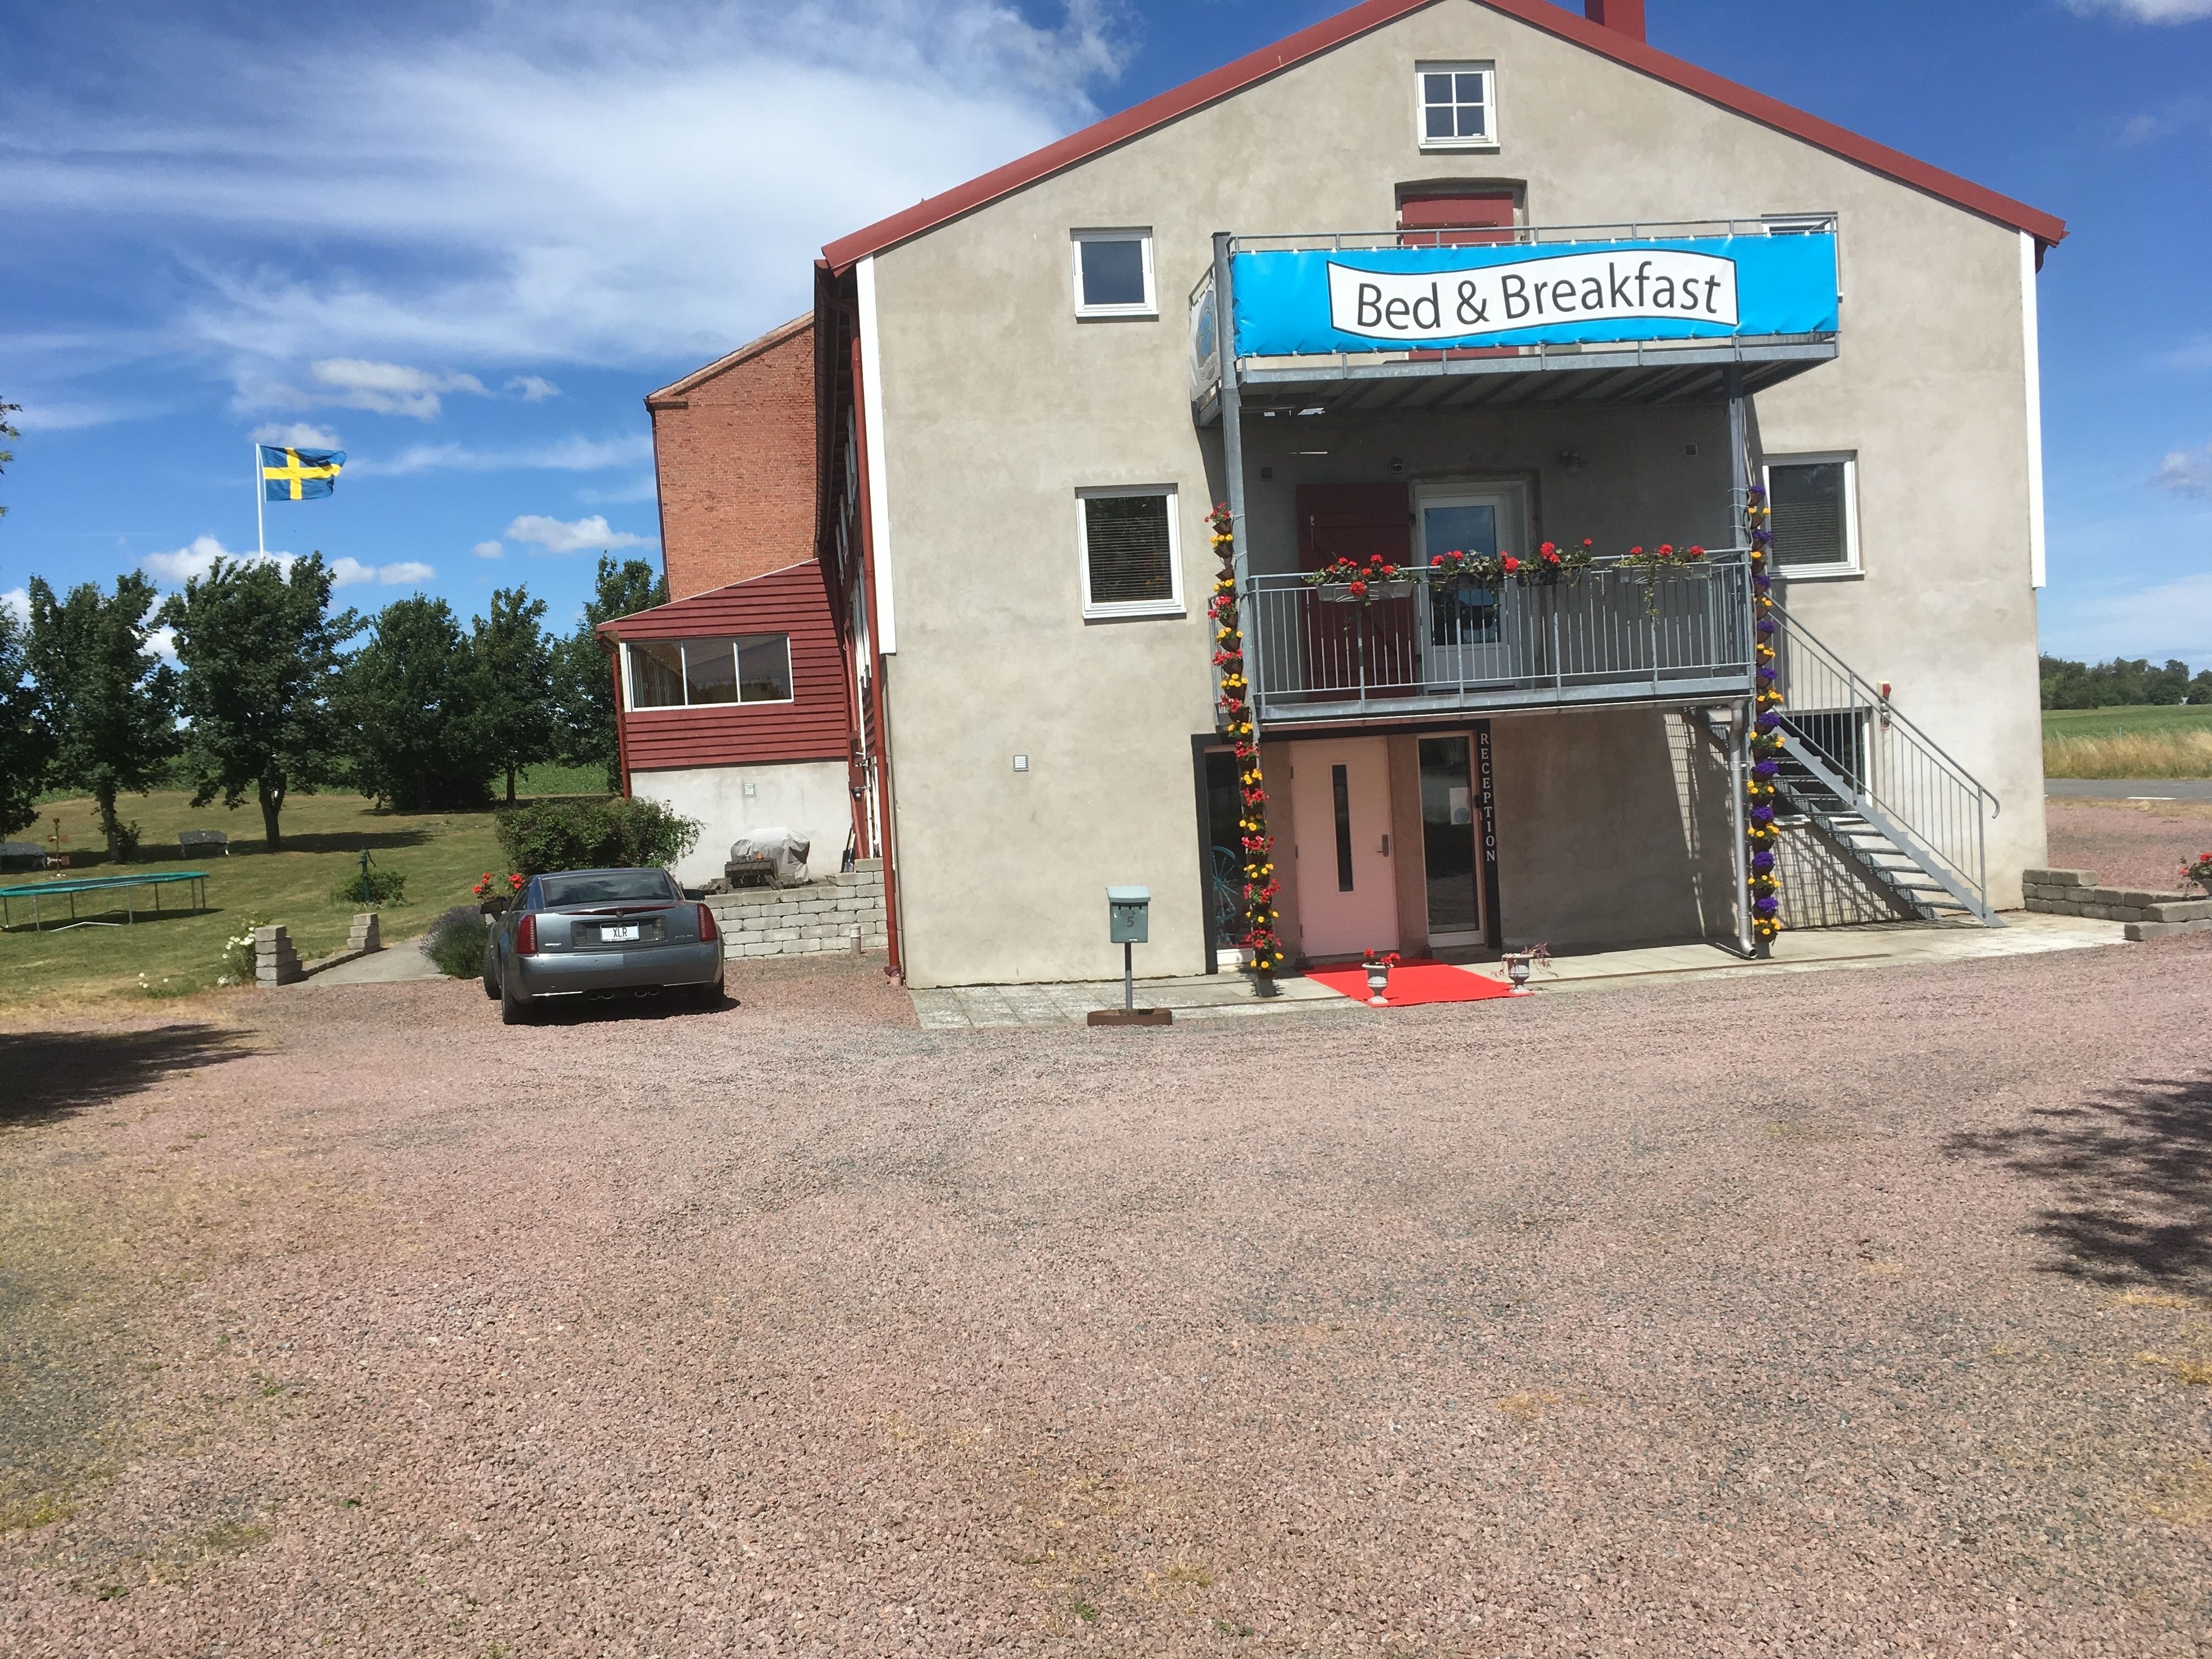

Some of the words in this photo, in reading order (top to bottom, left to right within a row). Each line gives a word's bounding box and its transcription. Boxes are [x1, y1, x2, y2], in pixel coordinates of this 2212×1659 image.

[1357, 282, 1441, 330] Bed
[1456, 279, 1490, 325] &
[1501, 261, 1721, 319] Breakfast
[1480, 733, 1496, 862] RECEPTION
[612, 927, 628, 938] XLR
[1126, 916, 1134, 927] 5
